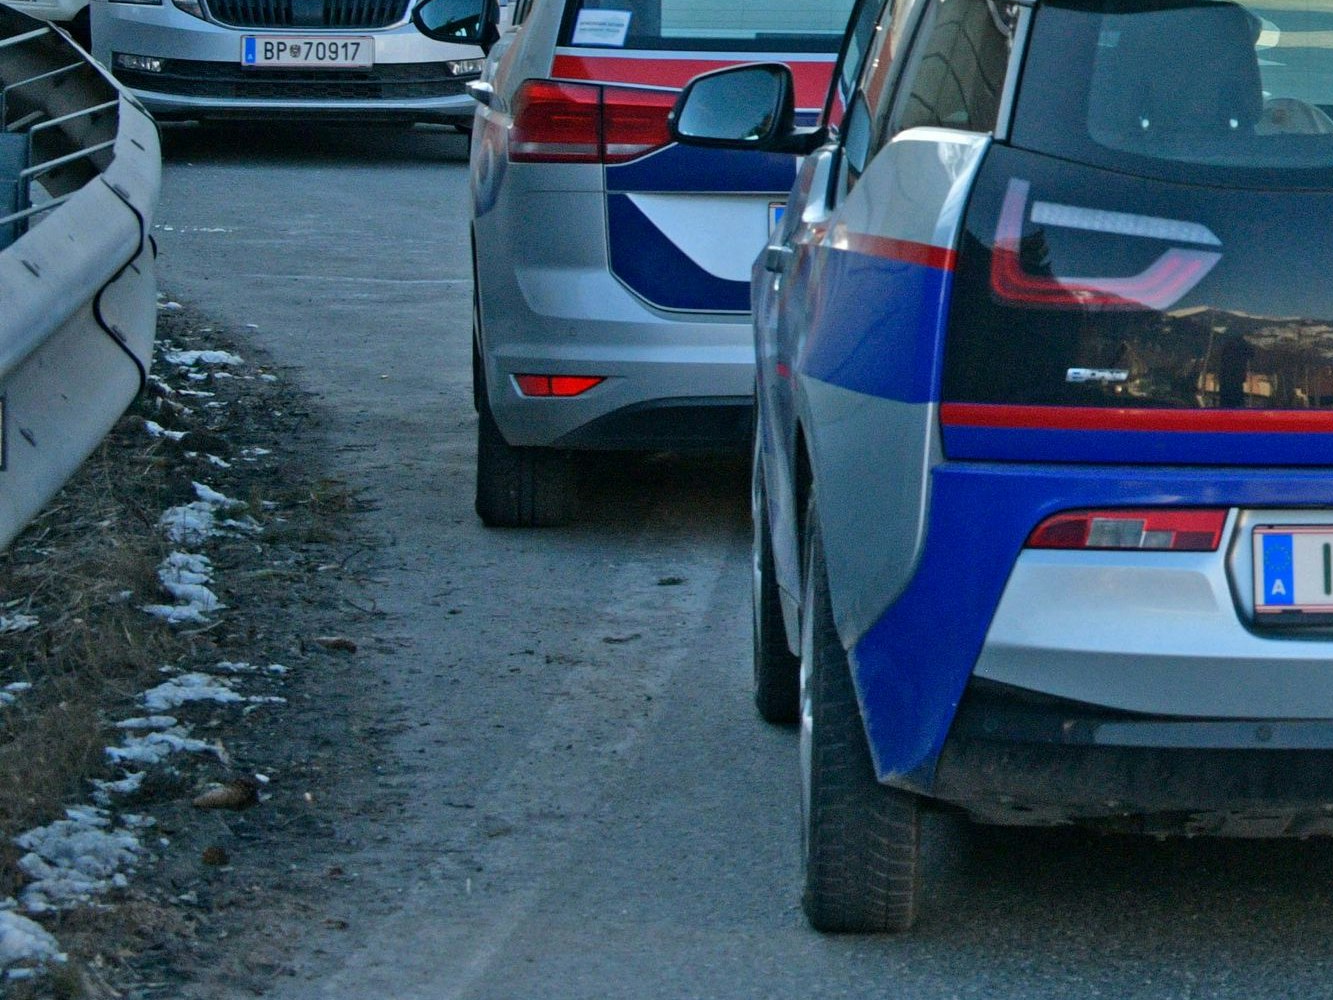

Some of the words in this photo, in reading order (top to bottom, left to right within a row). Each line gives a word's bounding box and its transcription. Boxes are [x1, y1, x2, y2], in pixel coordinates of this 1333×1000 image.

[264, 42, 287, 61] BP
[303, 41, 362, 61] 70917
[1271, 578, 1287, 596] A
